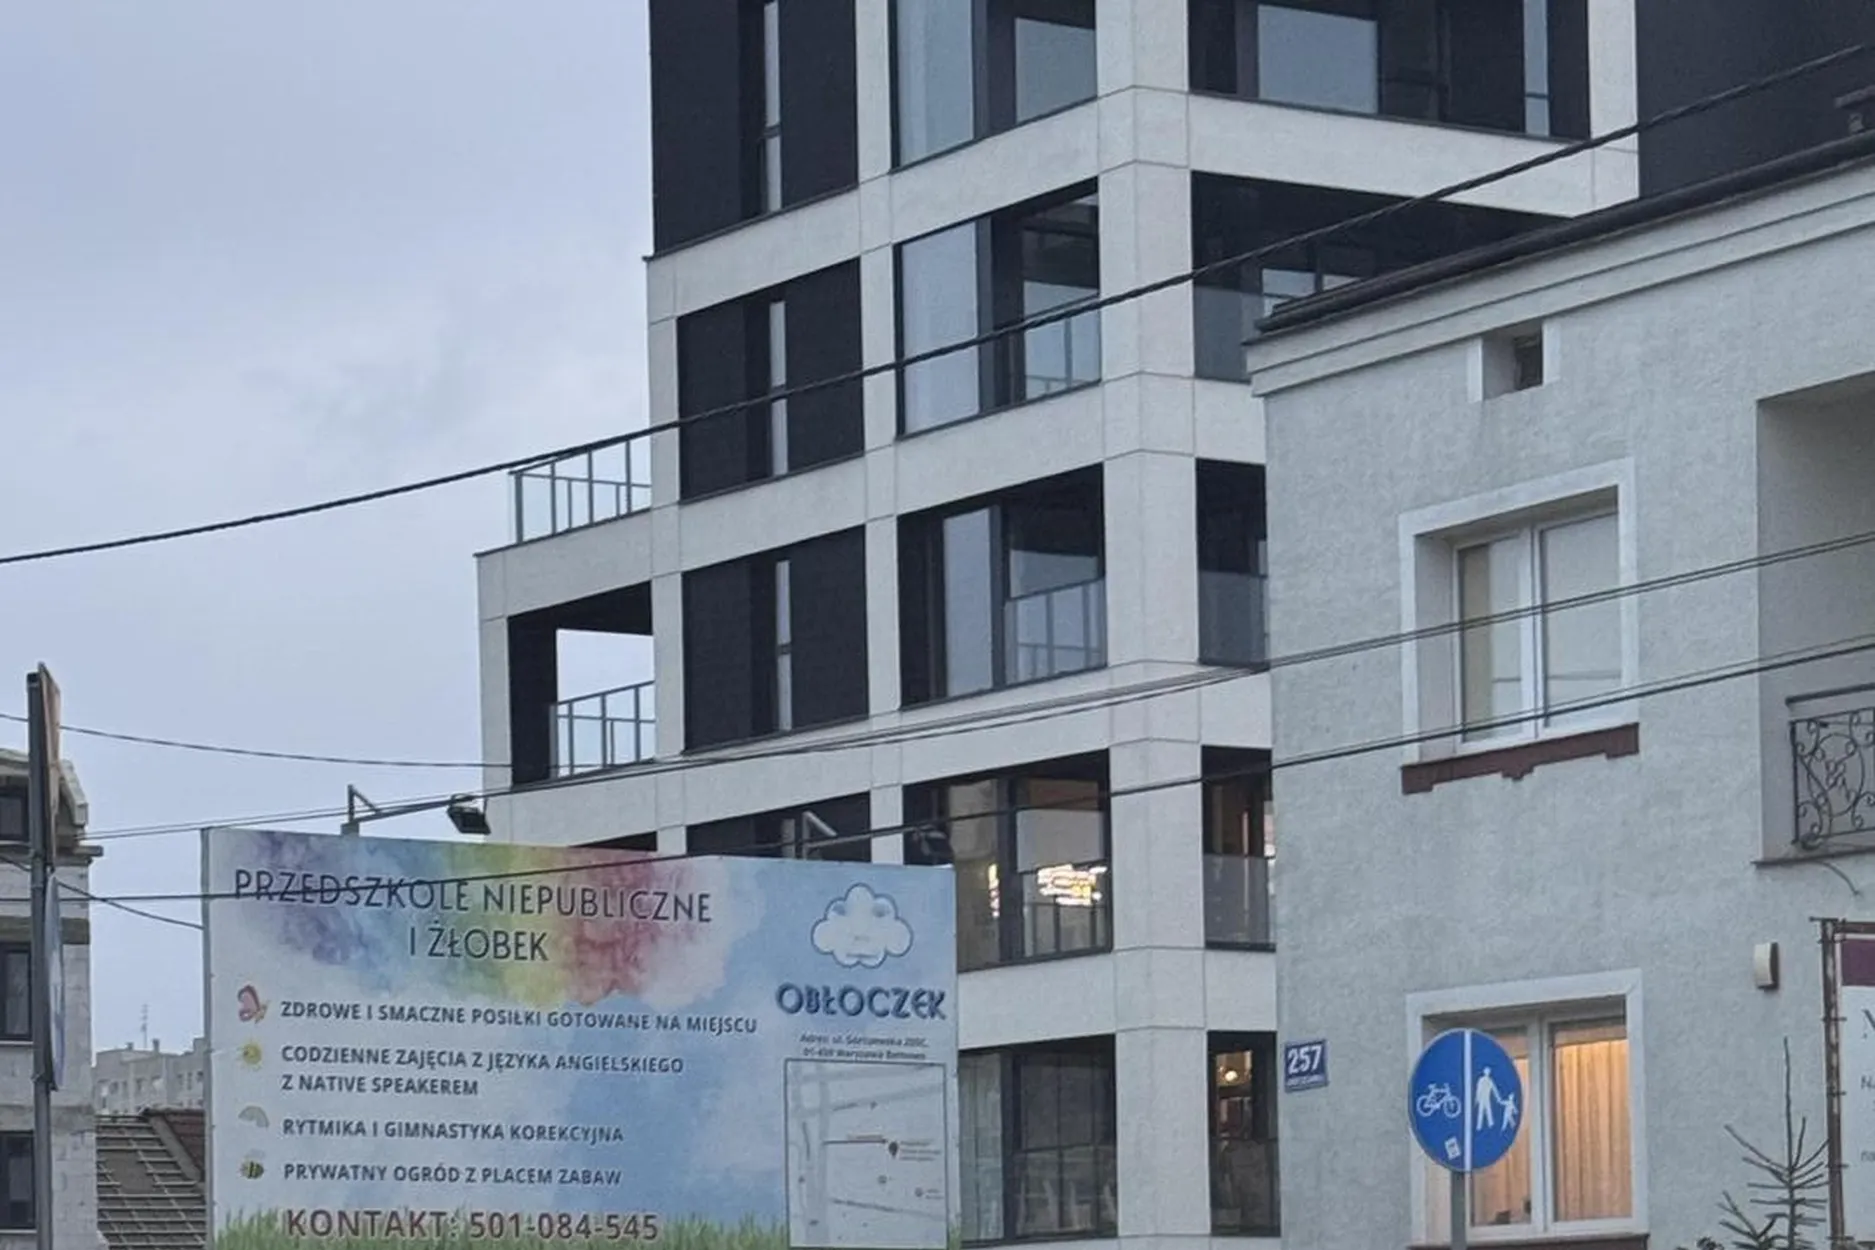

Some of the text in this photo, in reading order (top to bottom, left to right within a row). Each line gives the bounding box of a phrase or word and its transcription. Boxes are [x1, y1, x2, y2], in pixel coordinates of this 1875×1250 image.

[234, 868, 713, 923] PRZEDSZKOLE NIEPUBLICZNE
[409, 919, 550, 962] I ŻŁOBEK
[775, 981, 947, 1021] OBŁOCZEK
[281, 1001, 758, 1035] ZDROWE I SMACZNE POSIŁKI GOTOWANE NA MIEJSCU
[281, 1046, 685, 1074] CODZIENNE ZAJĘCIA Z JĘZYKA ANGIELSKIEGO
[1287, 1045, 1323, 1075] 257
[281, 1074, 479, 1096] Z NATIVE SPEAKEREM
[283, 1118, 625, 1146] RYTMIKA I GIMNASTYKA KOREKCYJNA
[283, 1161, 622, 1186] PRYWATNY OGRÓD Z PLACEM ZABAW
[287, 1209, 659, 1241] KONTAKT: 501-084-545
